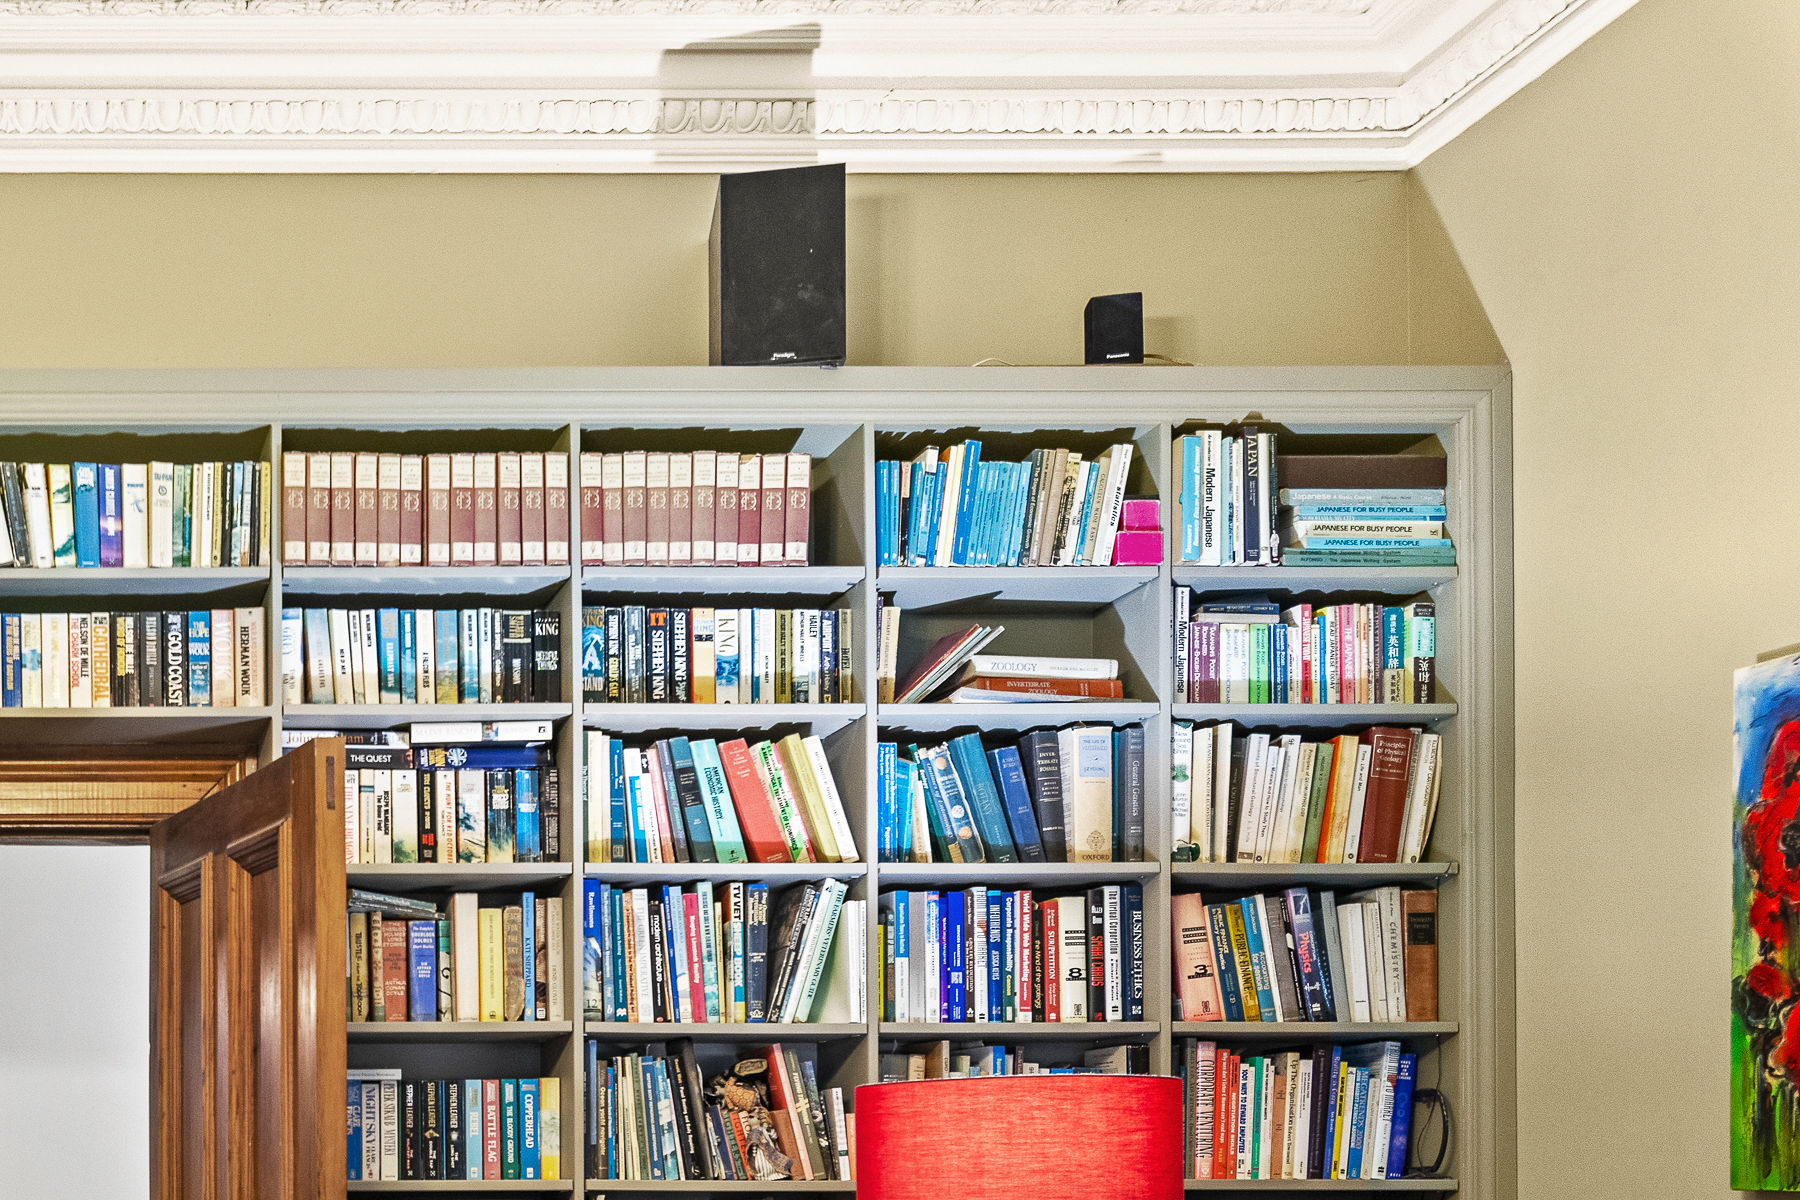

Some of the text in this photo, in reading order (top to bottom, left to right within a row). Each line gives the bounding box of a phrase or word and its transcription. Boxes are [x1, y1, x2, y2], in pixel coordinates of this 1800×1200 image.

[1247, 434, 1259, 478] JAPAN
[1202, 467, 1216, 548] Modern Japanese
[1312, 525, 1413, 534] JAPANESE FOR BUSY PEOPLE
[1358, 540, 1374, 548] FOR
[1375, 540, 1393, 548] BUSY
[1393, 540, 1420, 548] PEOPLE
[674, 612, 685, 681] STEPHEN KING
[809, 614, 818, 638] HAILEY
[822, 619, 833, 653] AIRPORT
[94, 625, 108, 701] CATHEDRAL
[168, 630, 182, 705] GOLD COAST
[240, 626, 251, 696] HERMAN WOUK
[652, 629, 665, 700] STEPHEN KING
[1176, 620, 1187, 694] Modern Japanese
[1345, 640, 1354, 679] JAPANESE
[1131, 760, 1141, 817] General Genetics
[587, 891, 596, 928] Rawlinsons
[733, 885, 744, 987] TV VET SHEEP BOOK
[1003, 896, 1013, 973] Corporate Responsibility
[1019, 892, 1031, 982] World Wide Web Marketing
[1048, 930, 1056, 980] SUR/PETITION
[1091, 935, 1105, 987] SMART CARDS
[1133, 910, 1143, 998] BUSINESS ETHICS
[1297, 933, 1314, 974] Physics
[365, 1086, 376, 1144] NIGHT SKY
[487, 1104, 497, 1163] BATTLE FLAG
[524, 1093, 536, 1149] COPPERHEAD
[1196, 1058, 1213, 1158] CORPORATE VENTURING
